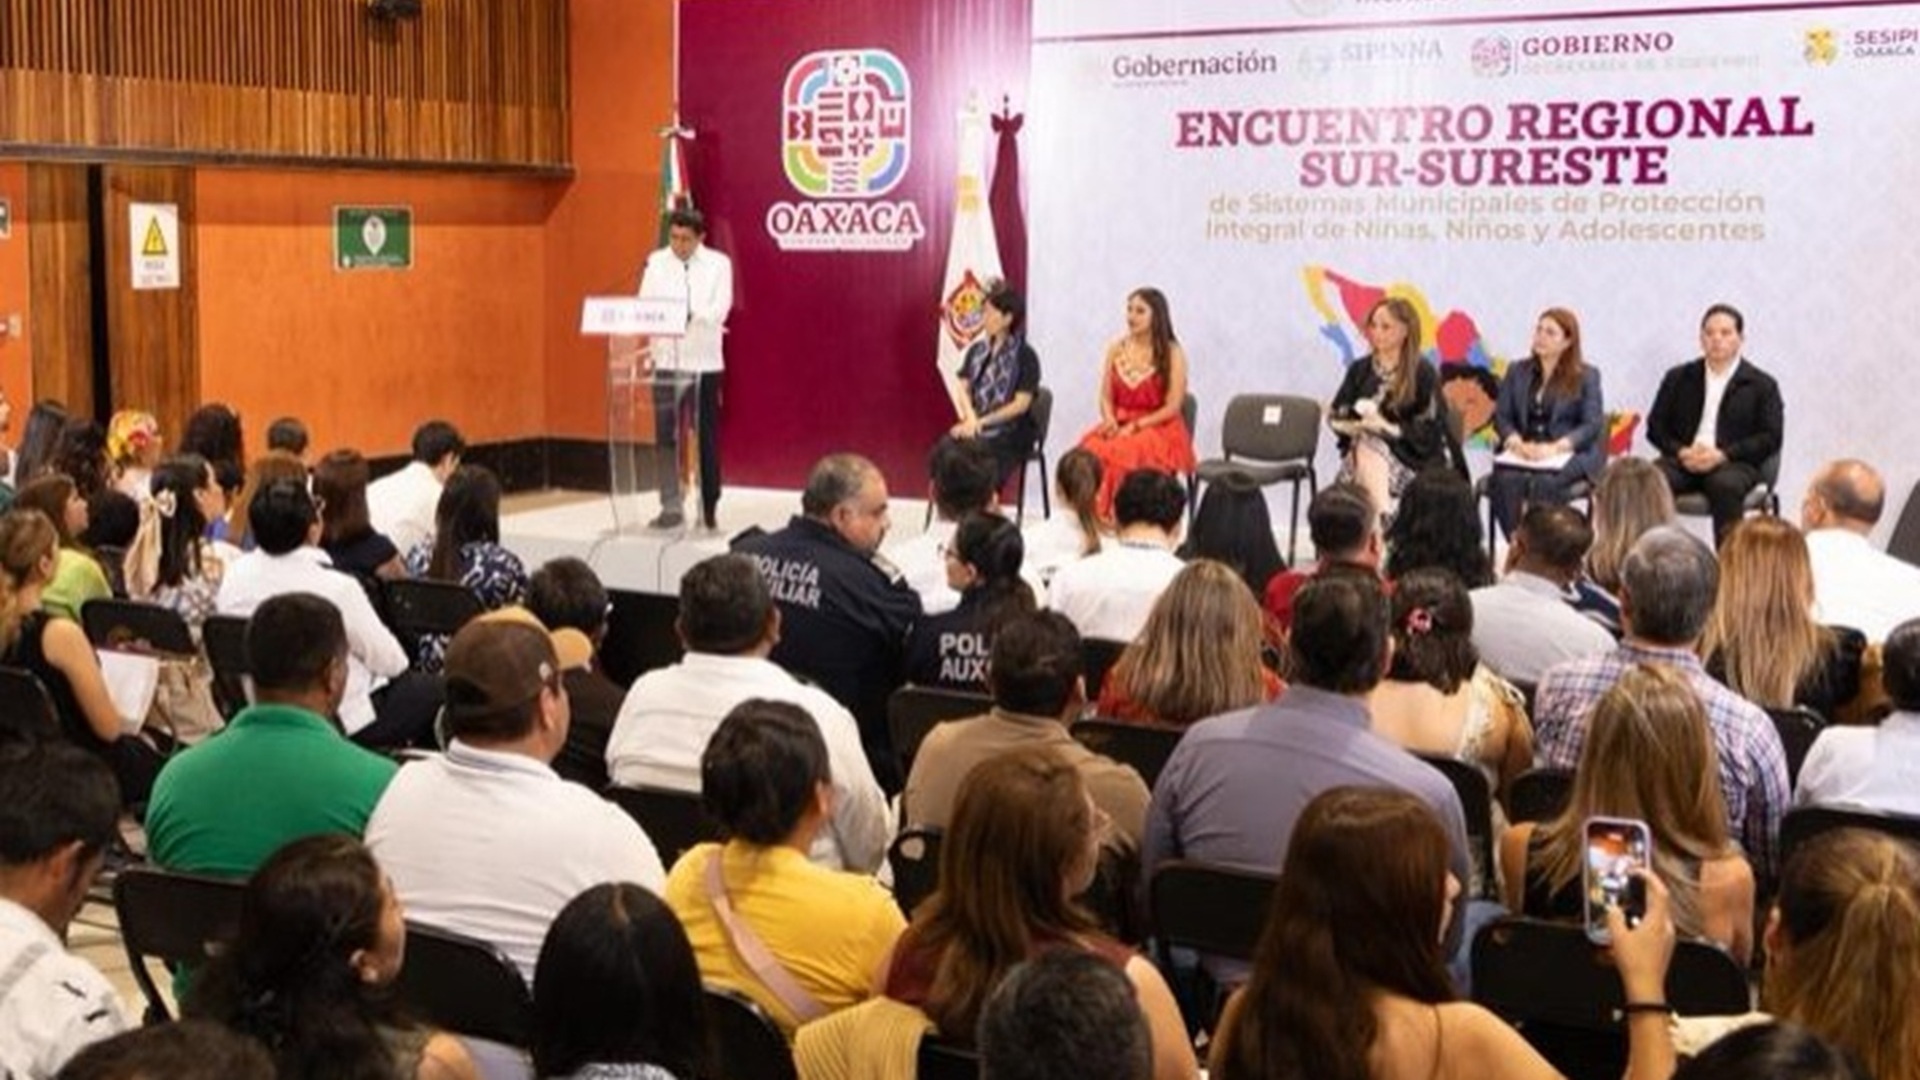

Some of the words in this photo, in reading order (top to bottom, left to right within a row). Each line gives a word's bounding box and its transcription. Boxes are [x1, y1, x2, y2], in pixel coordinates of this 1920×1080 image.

[1522, 32, 1674, 57] GOBIERNO
[1113, 50, 1277, 79] Gobernación
[1176, 104, 1493, 147] ENCUENTRO
[1506, 97, 1814, 141] REGIONAL
[1300, 146, 1669, 187] SUR-SURESTE
[1209, 193, 1241, 214] de
[1249, 192, 1365, 215] Sistemas
[1375, 190, 1544, 219] Municipales
[1552, 191, 1588, 213] de
[1600, 189, 1765, 213] Protección
[771, 206, 920, 234] OAXACA
[1206, 218, 1303, 243] Integral
[1313, 218, 1344, 239] de
[1446, 217, 1526, 240] Niños
[1532, 222, 1551, 246] y
[1559, 218, 1765, 241] Adolescentes
